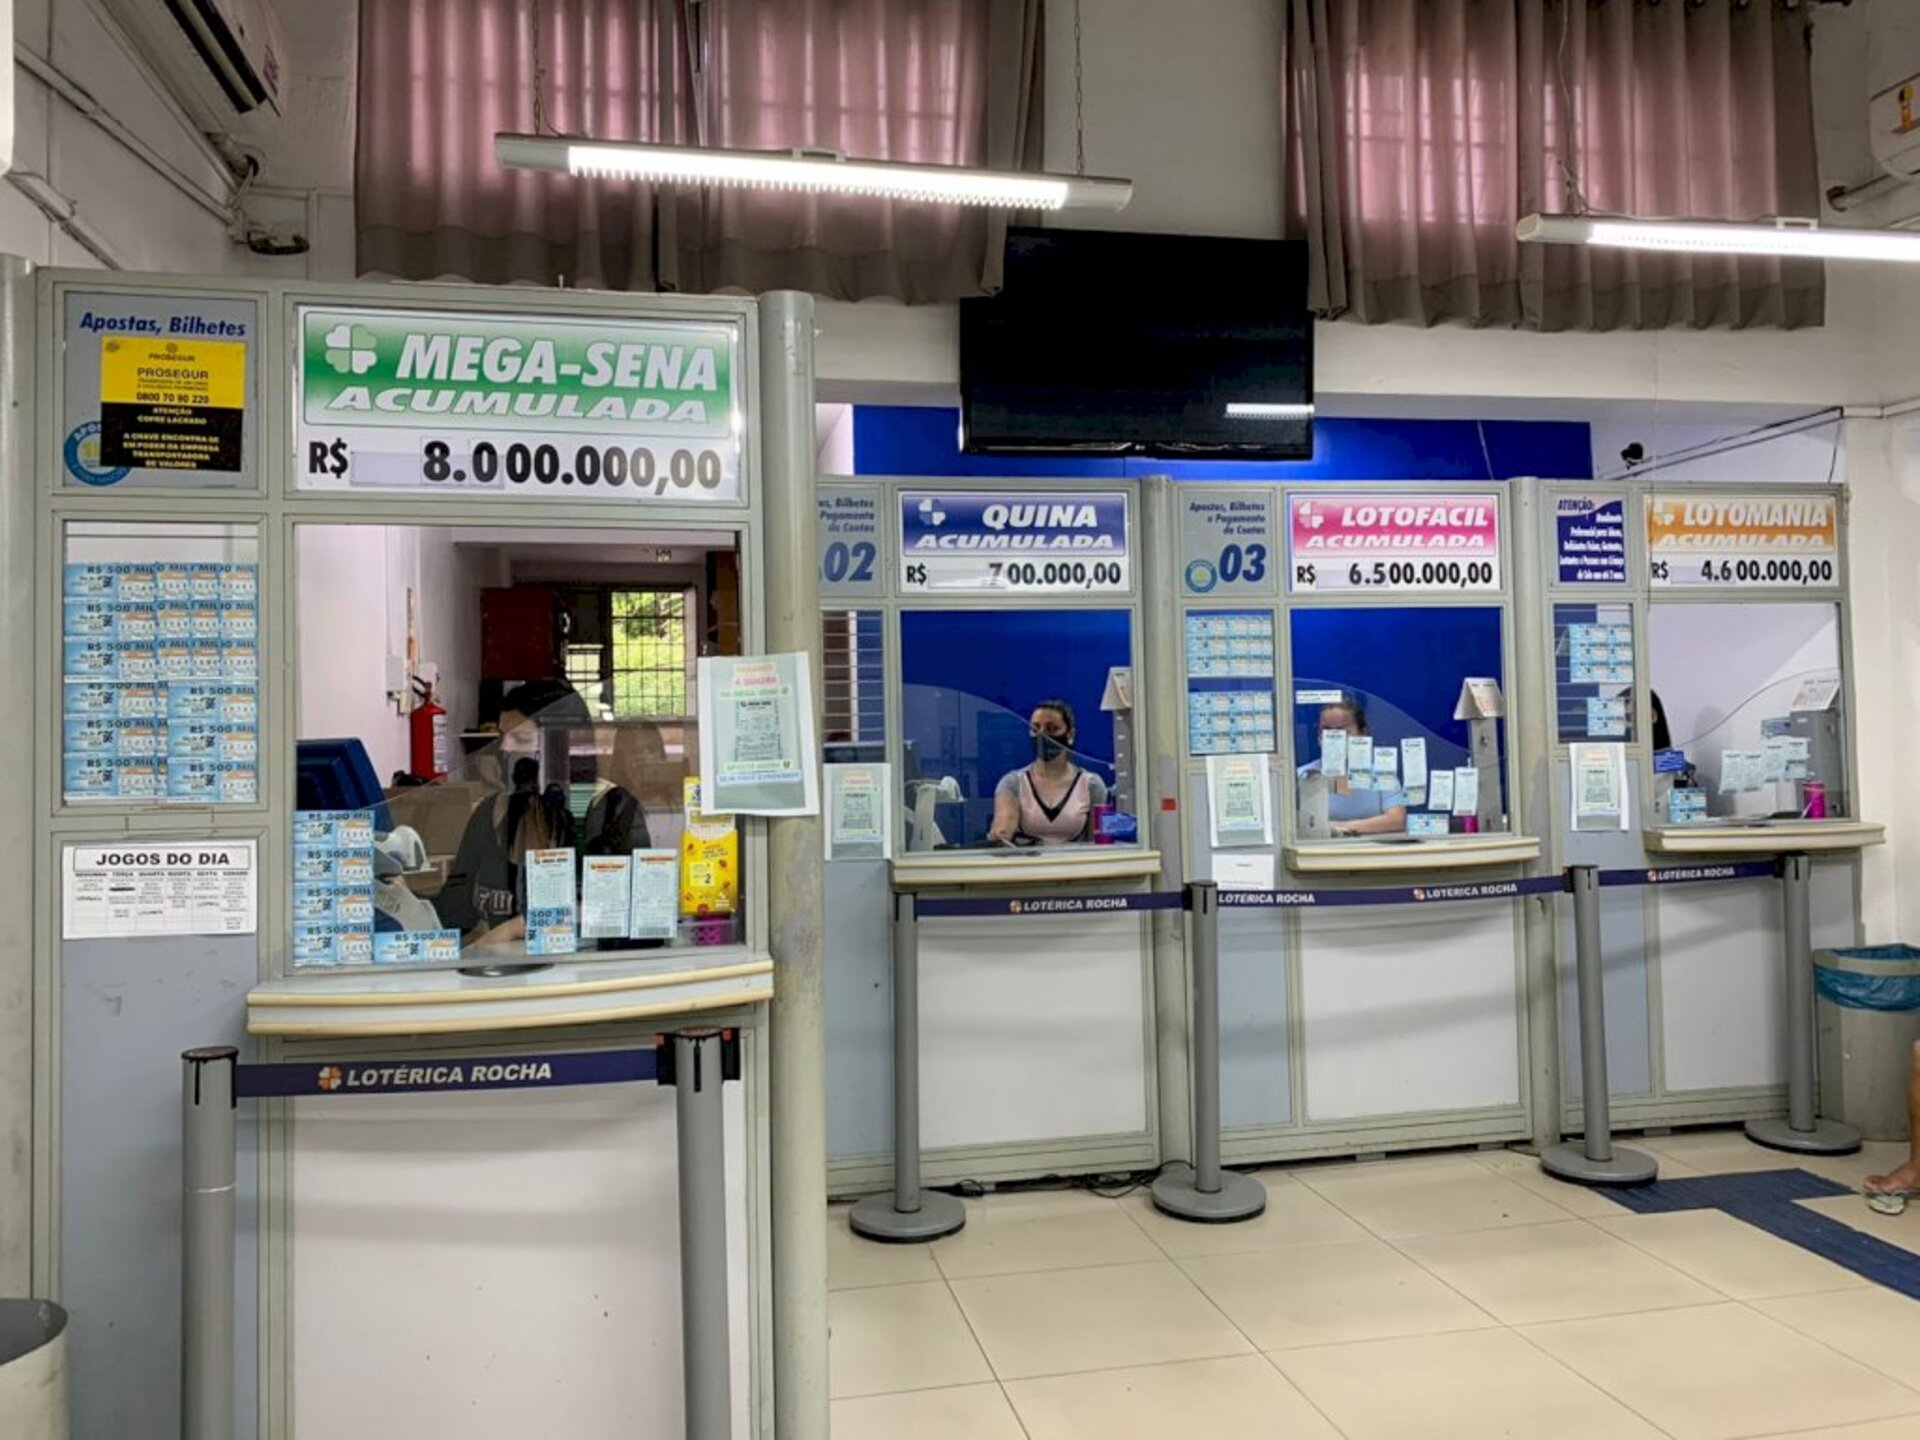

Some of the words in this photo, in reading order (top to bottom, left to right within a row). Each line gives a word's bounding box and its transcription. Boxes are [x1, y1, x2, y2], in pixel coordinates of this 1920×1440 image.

[80, 312, 162, 336] Apostas,
[169, 316, 246, 336] Bilhetes
[137, 367, 209, 379] PROSEGUR
[396, 334, 717, 391] MEGA-SENA
[327, 387, 709, 423] ACUMULADA
[309, 438, 349, 480] R$
[422, 440, 722, 495] 8.000.000,00
[982, 504, 1098, 530] QUINA
[1683, 501, 1828, 527] LOTOMANIA
[914, 534, 1114, 549] ACUMULADA
[1305, 534, 1485, 548] ACUMULADA
[1658, 534, 1825, 549] ACUMULADA
[823, 542, 877, 582] 02
[1219, 543, 1267, 582] 03
[1651, 560, 1669, 580] R$
[1701, 560, 1832, 585] 4.600.000,00
[907, 563, 927, 585] R$
[989, 562, 1121, 588] 700.000,00
[1297, 563, 1316, 585] R$
[1349, 562, 1493, 588] 6.500.000,00
[96, 853, 161, 866] JOGOS
[166, 853, 192, 865] DO
[198, 853, 230, 865] DIA
[1276, 892, 1315, 903] ROCHA
[1481, 883, 1518, 895] ROCHA
[1086, 897, 1128, 909] ROCHA
[347, 1064, 463, 1086] LOTÉRICA
[470, 1062, 553, 1082] ROCHA
